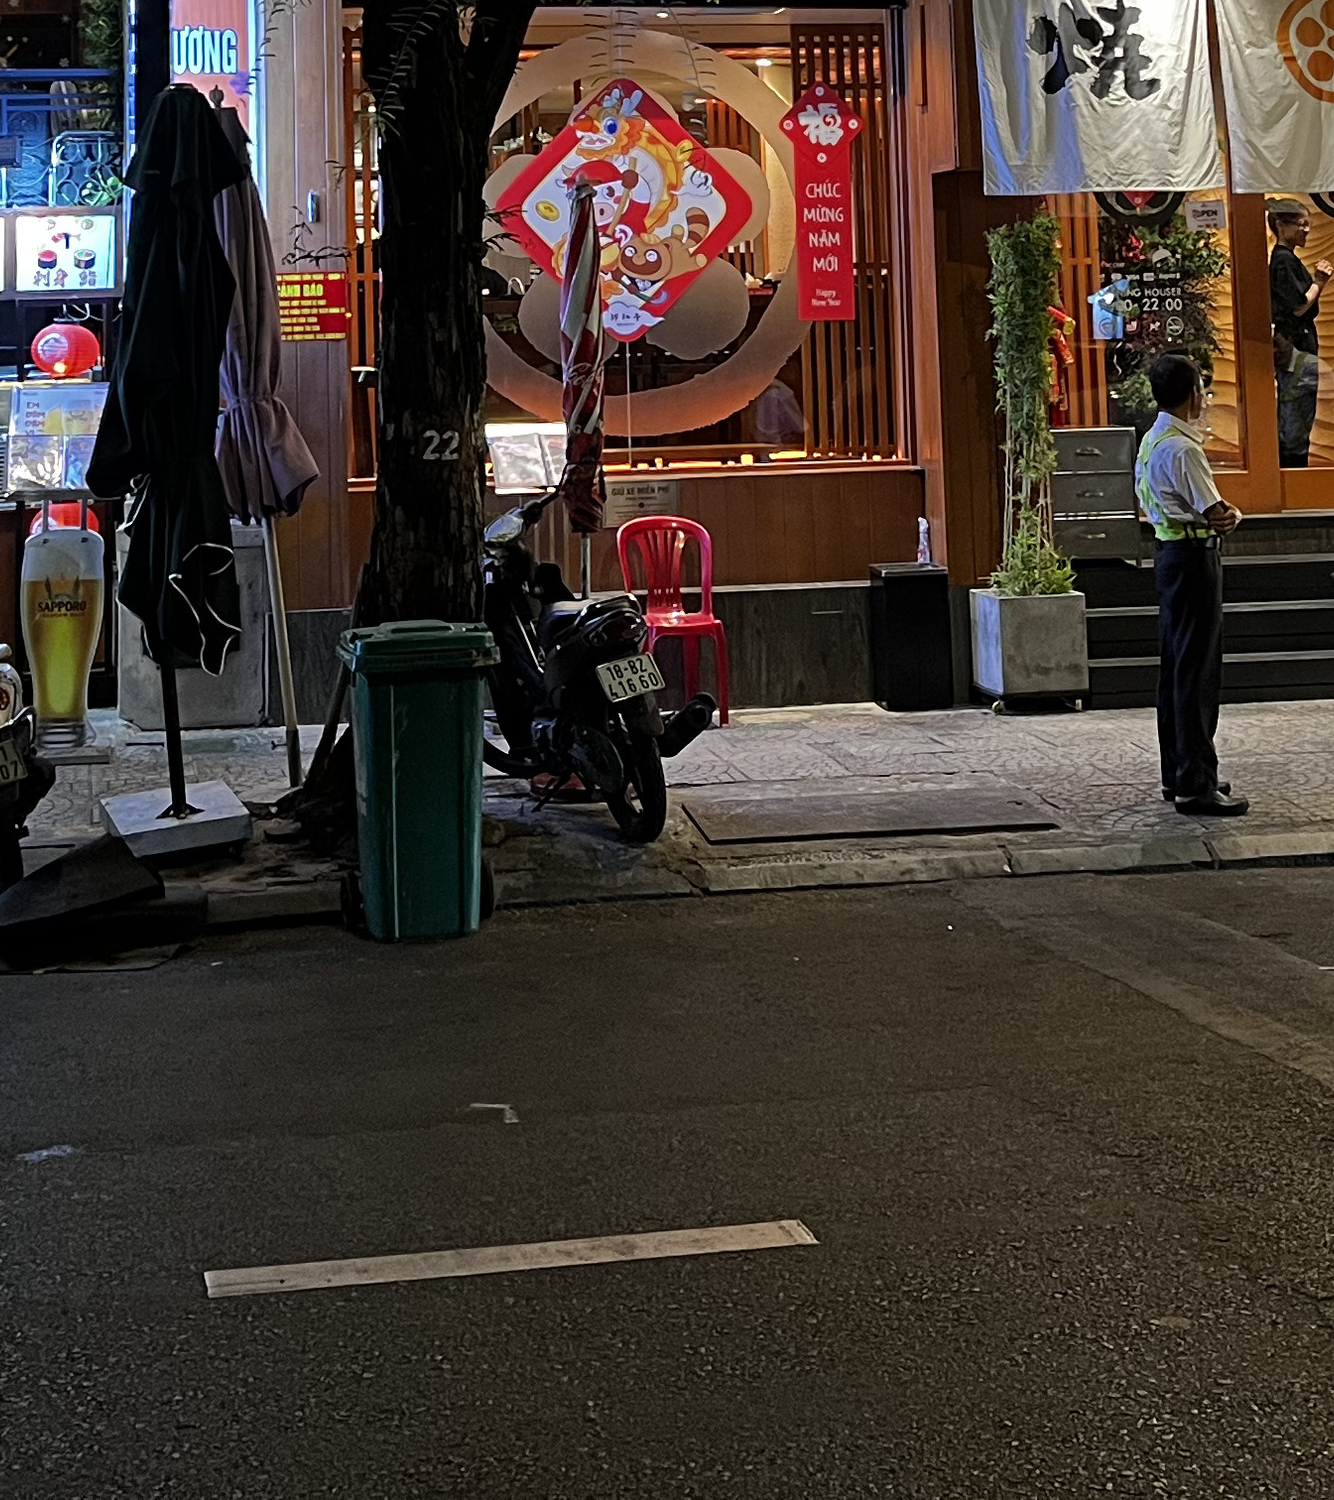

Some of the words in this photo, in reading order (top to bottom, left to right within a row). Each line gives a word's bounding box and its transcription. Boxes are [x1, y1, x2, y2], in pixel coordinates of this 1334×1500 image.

[172, 25, 238, 75] ƯƠNG
[805, 180, 842, 199] CHÚC
[803, 204, 845, 223] MỪNG
[809, 229, 841, 248] NĂM
[812, 253, 839, 273] MỚI
[422, 429, 460, 460] 22
[37, 600, 87, 613] SAPPORO
